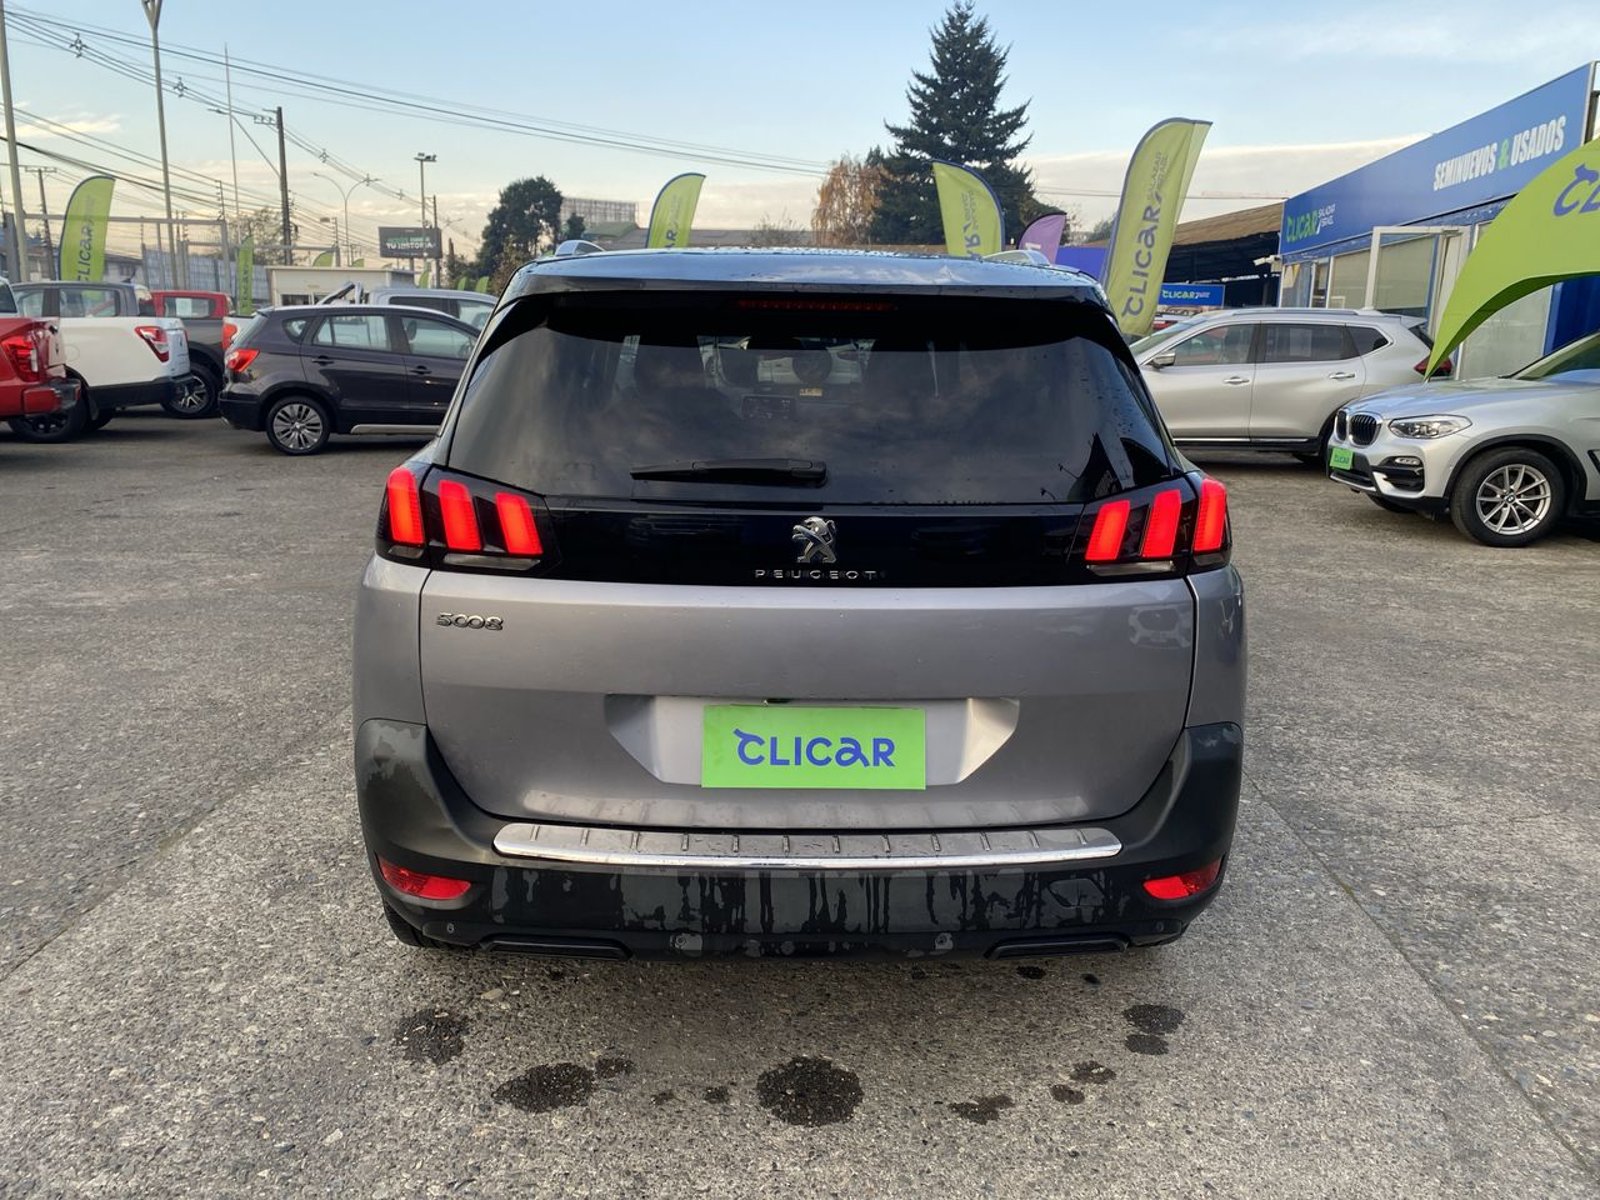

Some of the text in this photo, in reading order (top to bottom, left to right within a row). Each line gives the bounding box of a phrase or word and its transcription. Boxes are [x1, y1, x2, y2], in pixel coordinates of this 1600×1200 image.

[1433, 115, 1567, 191] SEMINUEVOS & USADOS
[755, 569, 877, 580] PEUGEOT
[436, 611, 504, 631] 5008
